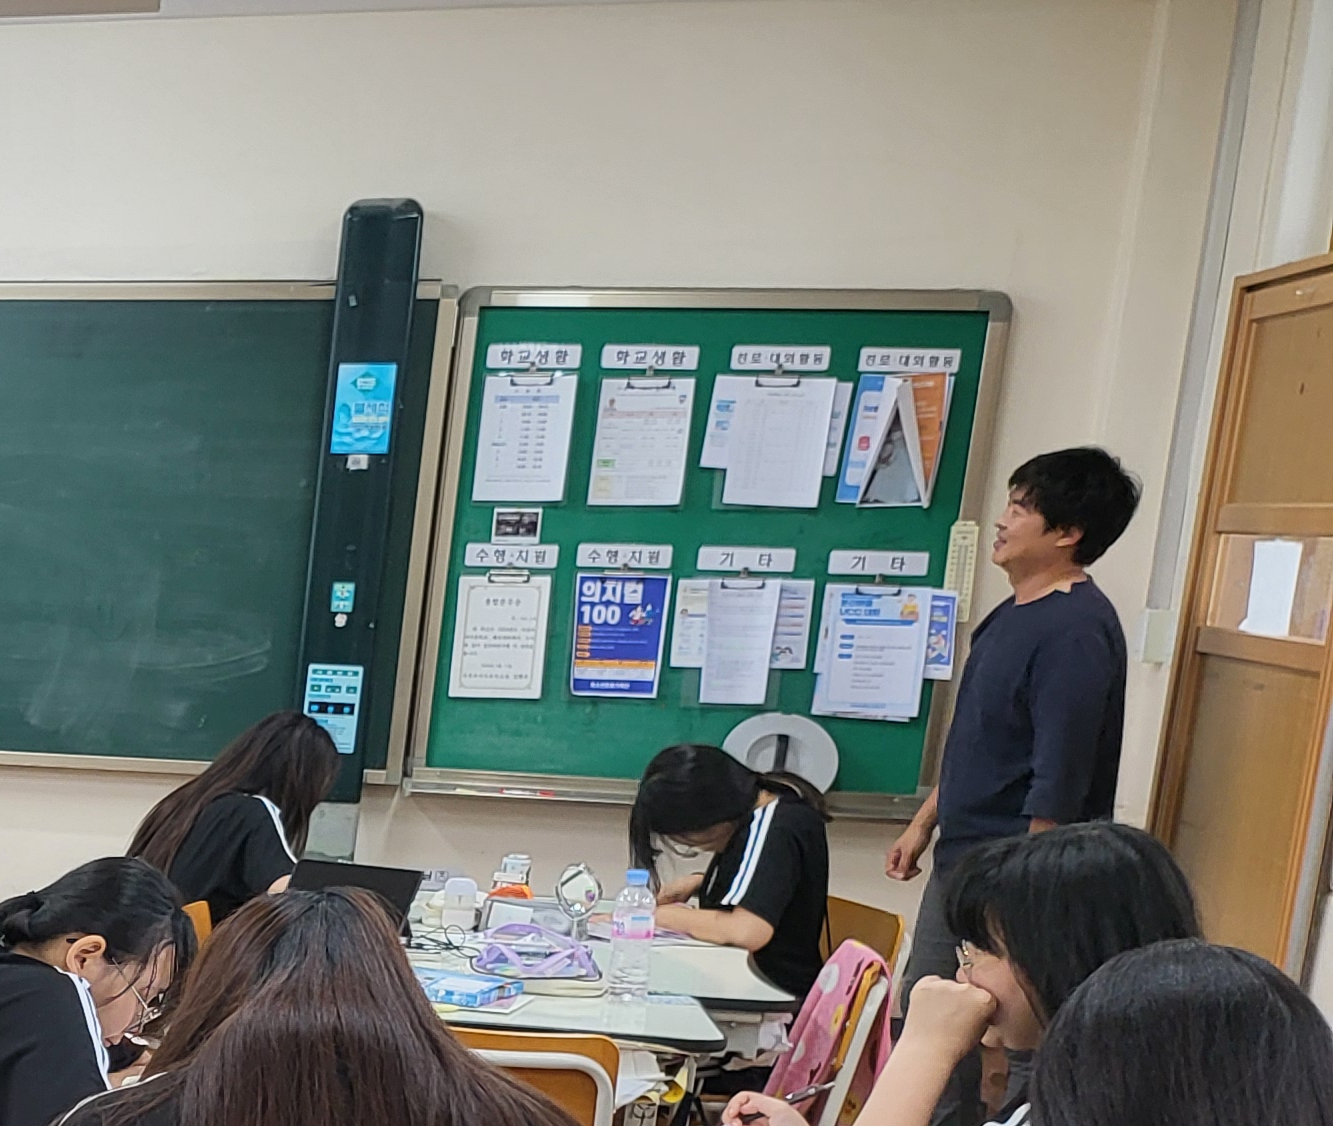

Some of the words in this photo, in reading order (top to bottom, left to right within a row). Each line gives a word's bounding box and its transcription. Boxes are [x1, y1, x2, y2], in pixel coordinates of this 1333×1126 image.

[500, 349, 569, 365] 학교생활
[616, 350, 687, 366] 학교생활
[580, 604, 621, 625] 100
